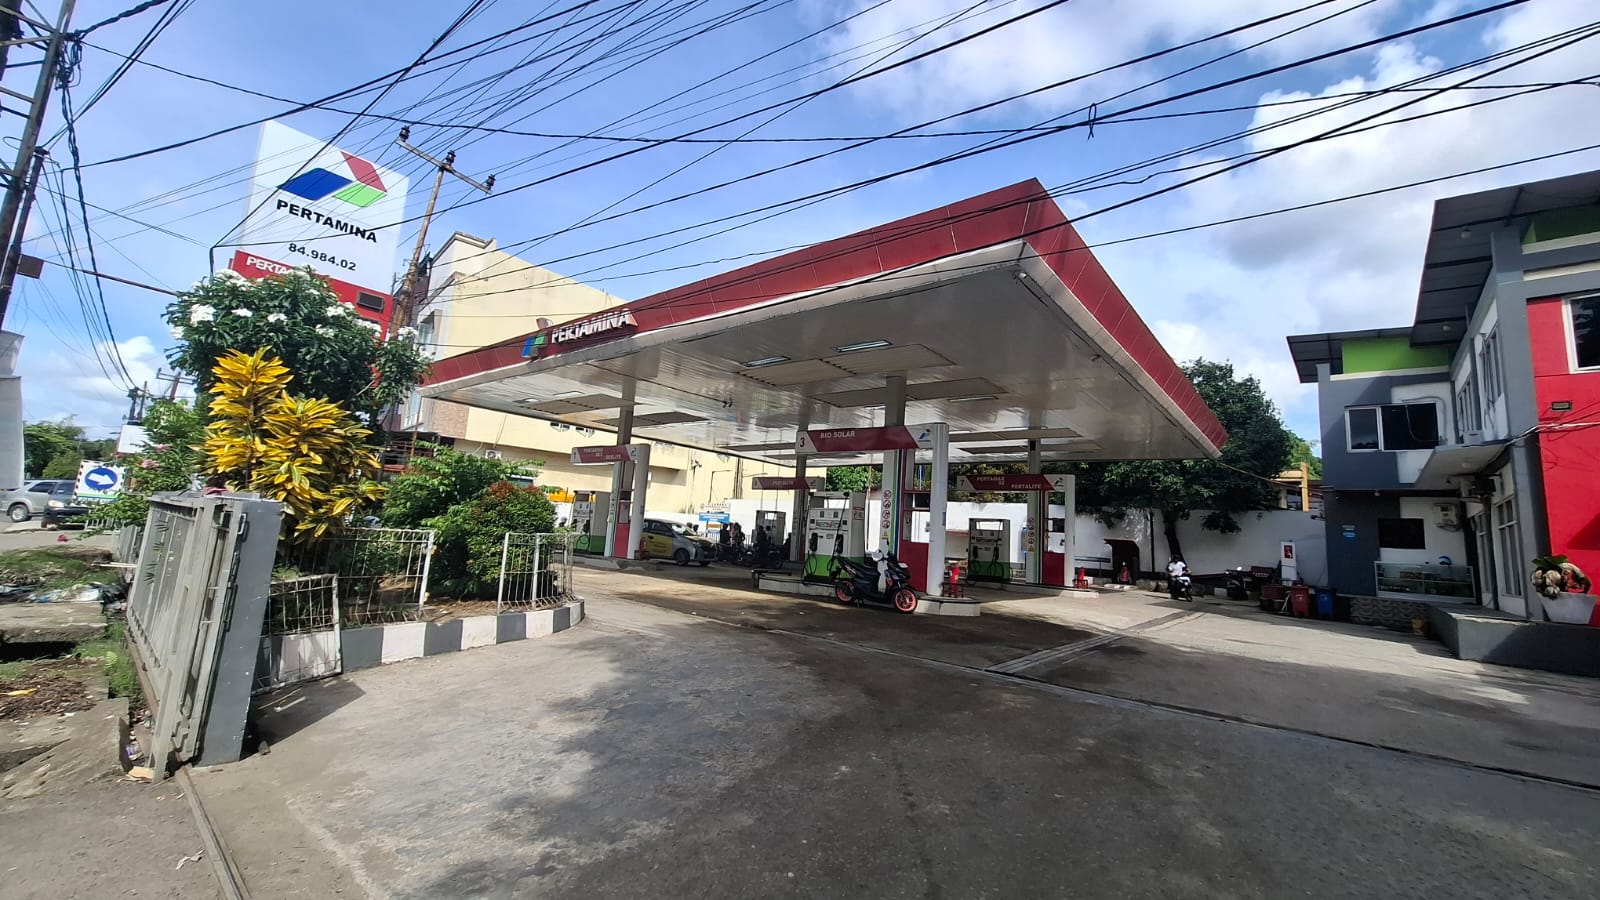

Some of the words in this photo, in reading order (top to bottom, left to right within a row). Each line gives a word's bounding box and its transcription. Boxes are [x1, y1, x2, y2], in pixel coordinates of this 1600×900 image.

[276, 199, 377, 243] PERTAMINA
[288, 243, 357, 271] 84.984.02
[551, 308, 638, 344] PERTAMINA
[799, 437, 805, 447] 3
[833, 430, 856, 438] SOLAR
